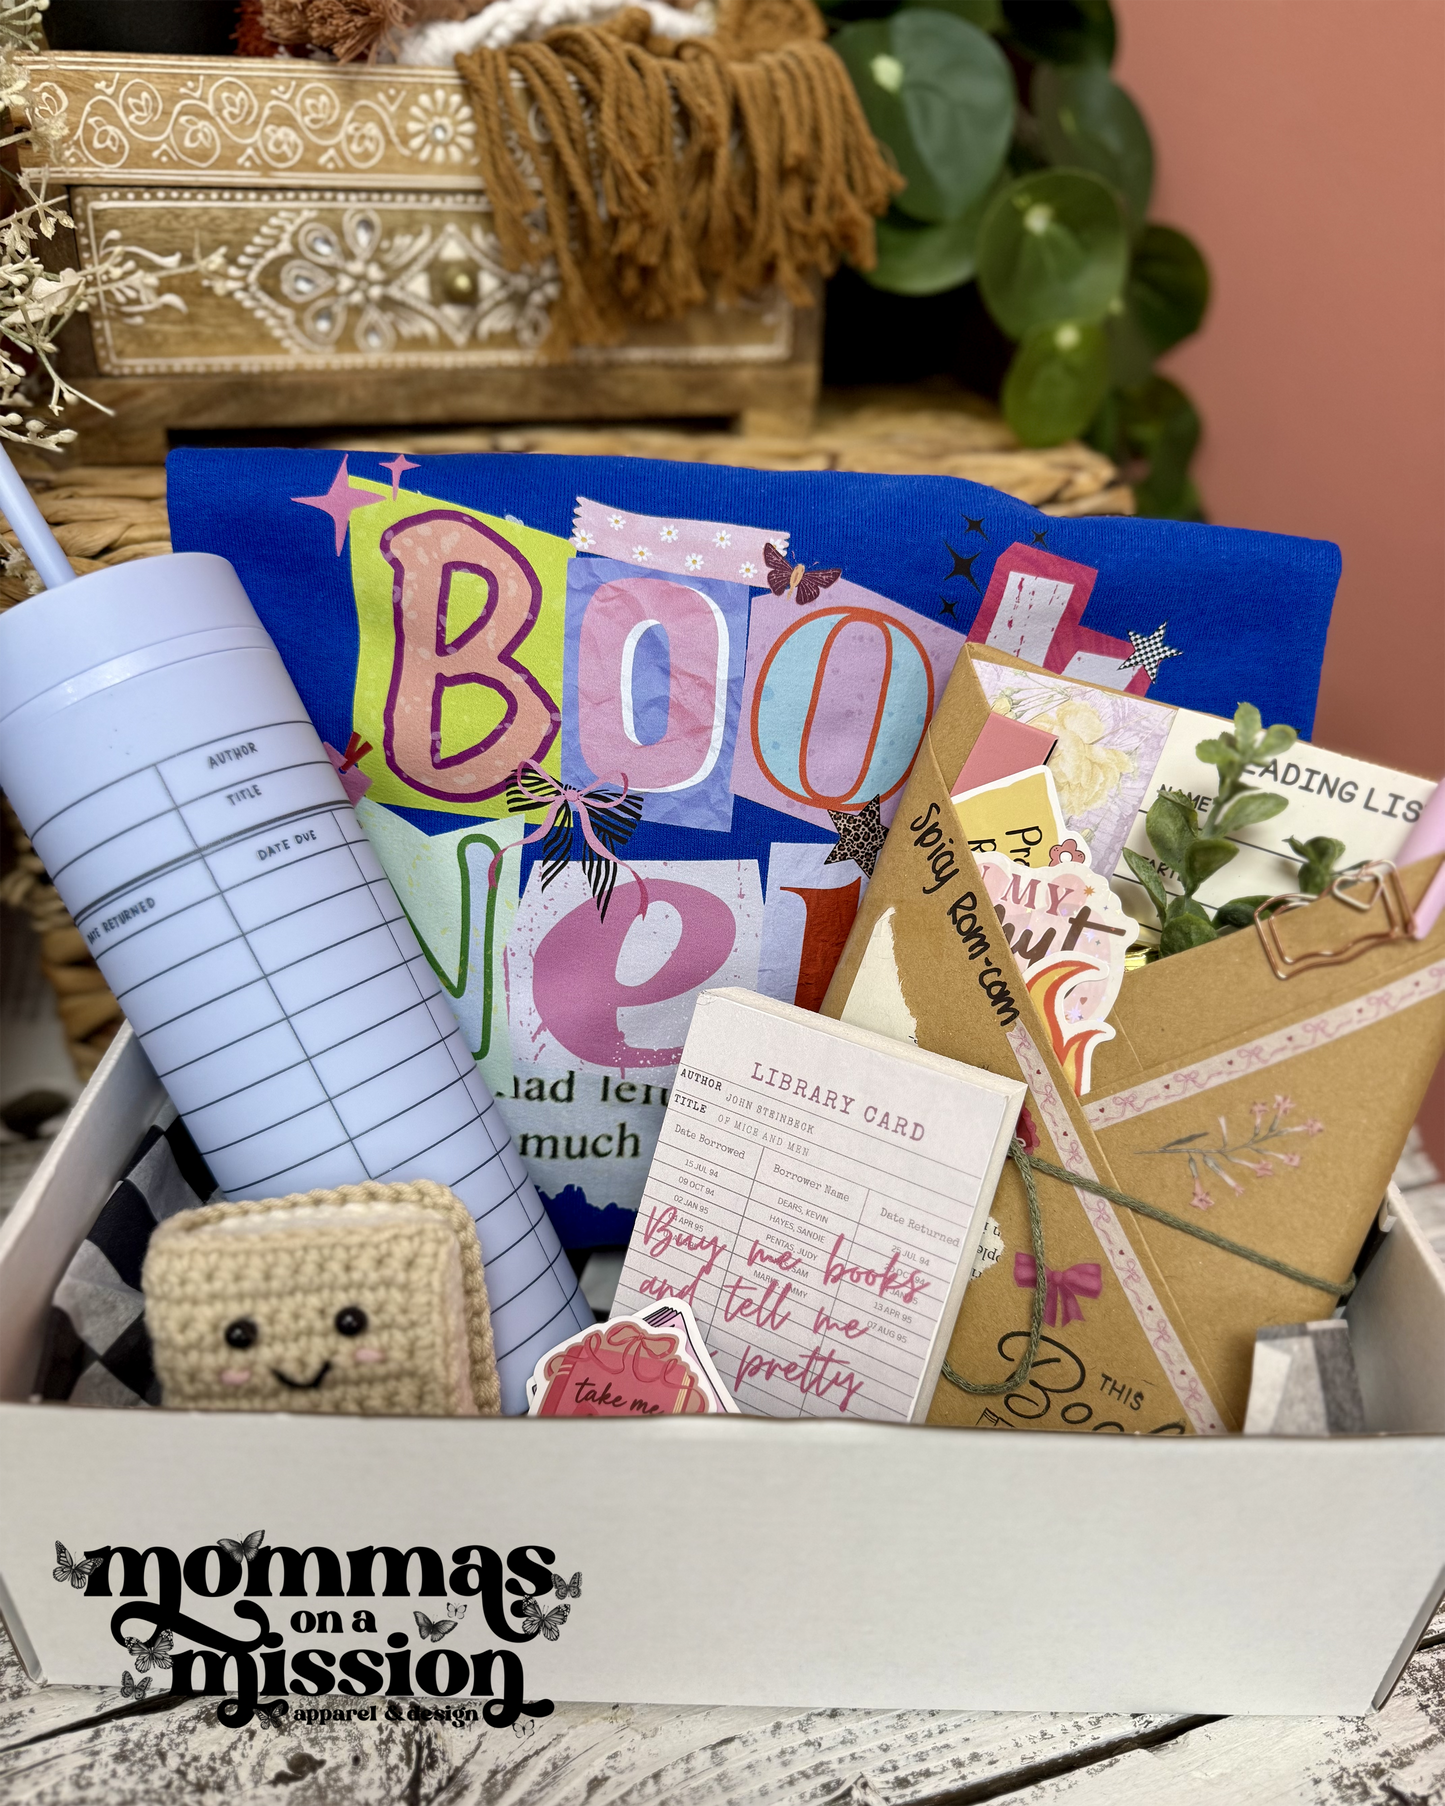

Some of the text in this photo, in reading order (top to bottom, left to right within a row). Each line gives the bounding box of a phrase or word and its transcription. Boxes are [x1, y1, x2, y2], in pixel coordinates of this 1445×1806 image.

[207, 742, 258, 769] AUTHOR
[226, 784, 262, 806] TITLE
[1245, 758, 1426, 823] ADING LIS
[257, 830, 317, 861] DATE DUE
[1000, 873, 1075, 916] MY
[102, 897, 156, 933] RETURNED
[910, 803, 959, 894] Spicy
[947, 891, 1020, 1026] Rom-com
[680, 1068, 815, 1135] AUTHOR JOHN STEINBECK
[751, 1062, 926, 1142] LIBRARY CARD
[519, 1121, 641, 1160] much
[674, 1094, 810, 1157] TITLE OF MICE AND MEN
[675, 1124, 746, 1159] Date Borrowed
[678, 1176, 715, 1197] 09 OCT 94
[684, 1159, 719, 1178] 15 JUL 94
[773, 1163, 850, 1202] Borrower Name
[673, 1194, 709, 1215] 02 JAN 95
[777, 1197, 829, 1224] DEARS, KEVIN
[678, 1217, 694, 1228] APR
[694, 1223, 704, 1233] 95
[769, 1214, 826, 1244] HAYES, SANDIE
[880, 1207, 905, 1225] Date
[907, 1218, 961, 1248] Returned
[643, 1205, 931, 1304] Buy me books
[797, 1248, 819, 1261] JUDY
[902, 1250, 916, 1261] JUL
[919, 1256, 930, 1266] 94
[639, 1265, 870, 1339] and tell me
[873, 1301, 912, 1324] 13 APR 95
[877, 1326, 895, 1339] AUG
[896, 1333, 908, 1343] 95
[575, 1377, 664, 1415] take me
[734, 1345, 864, 1412] pretty
[1100, 1373, 1145, 1411] THIS
